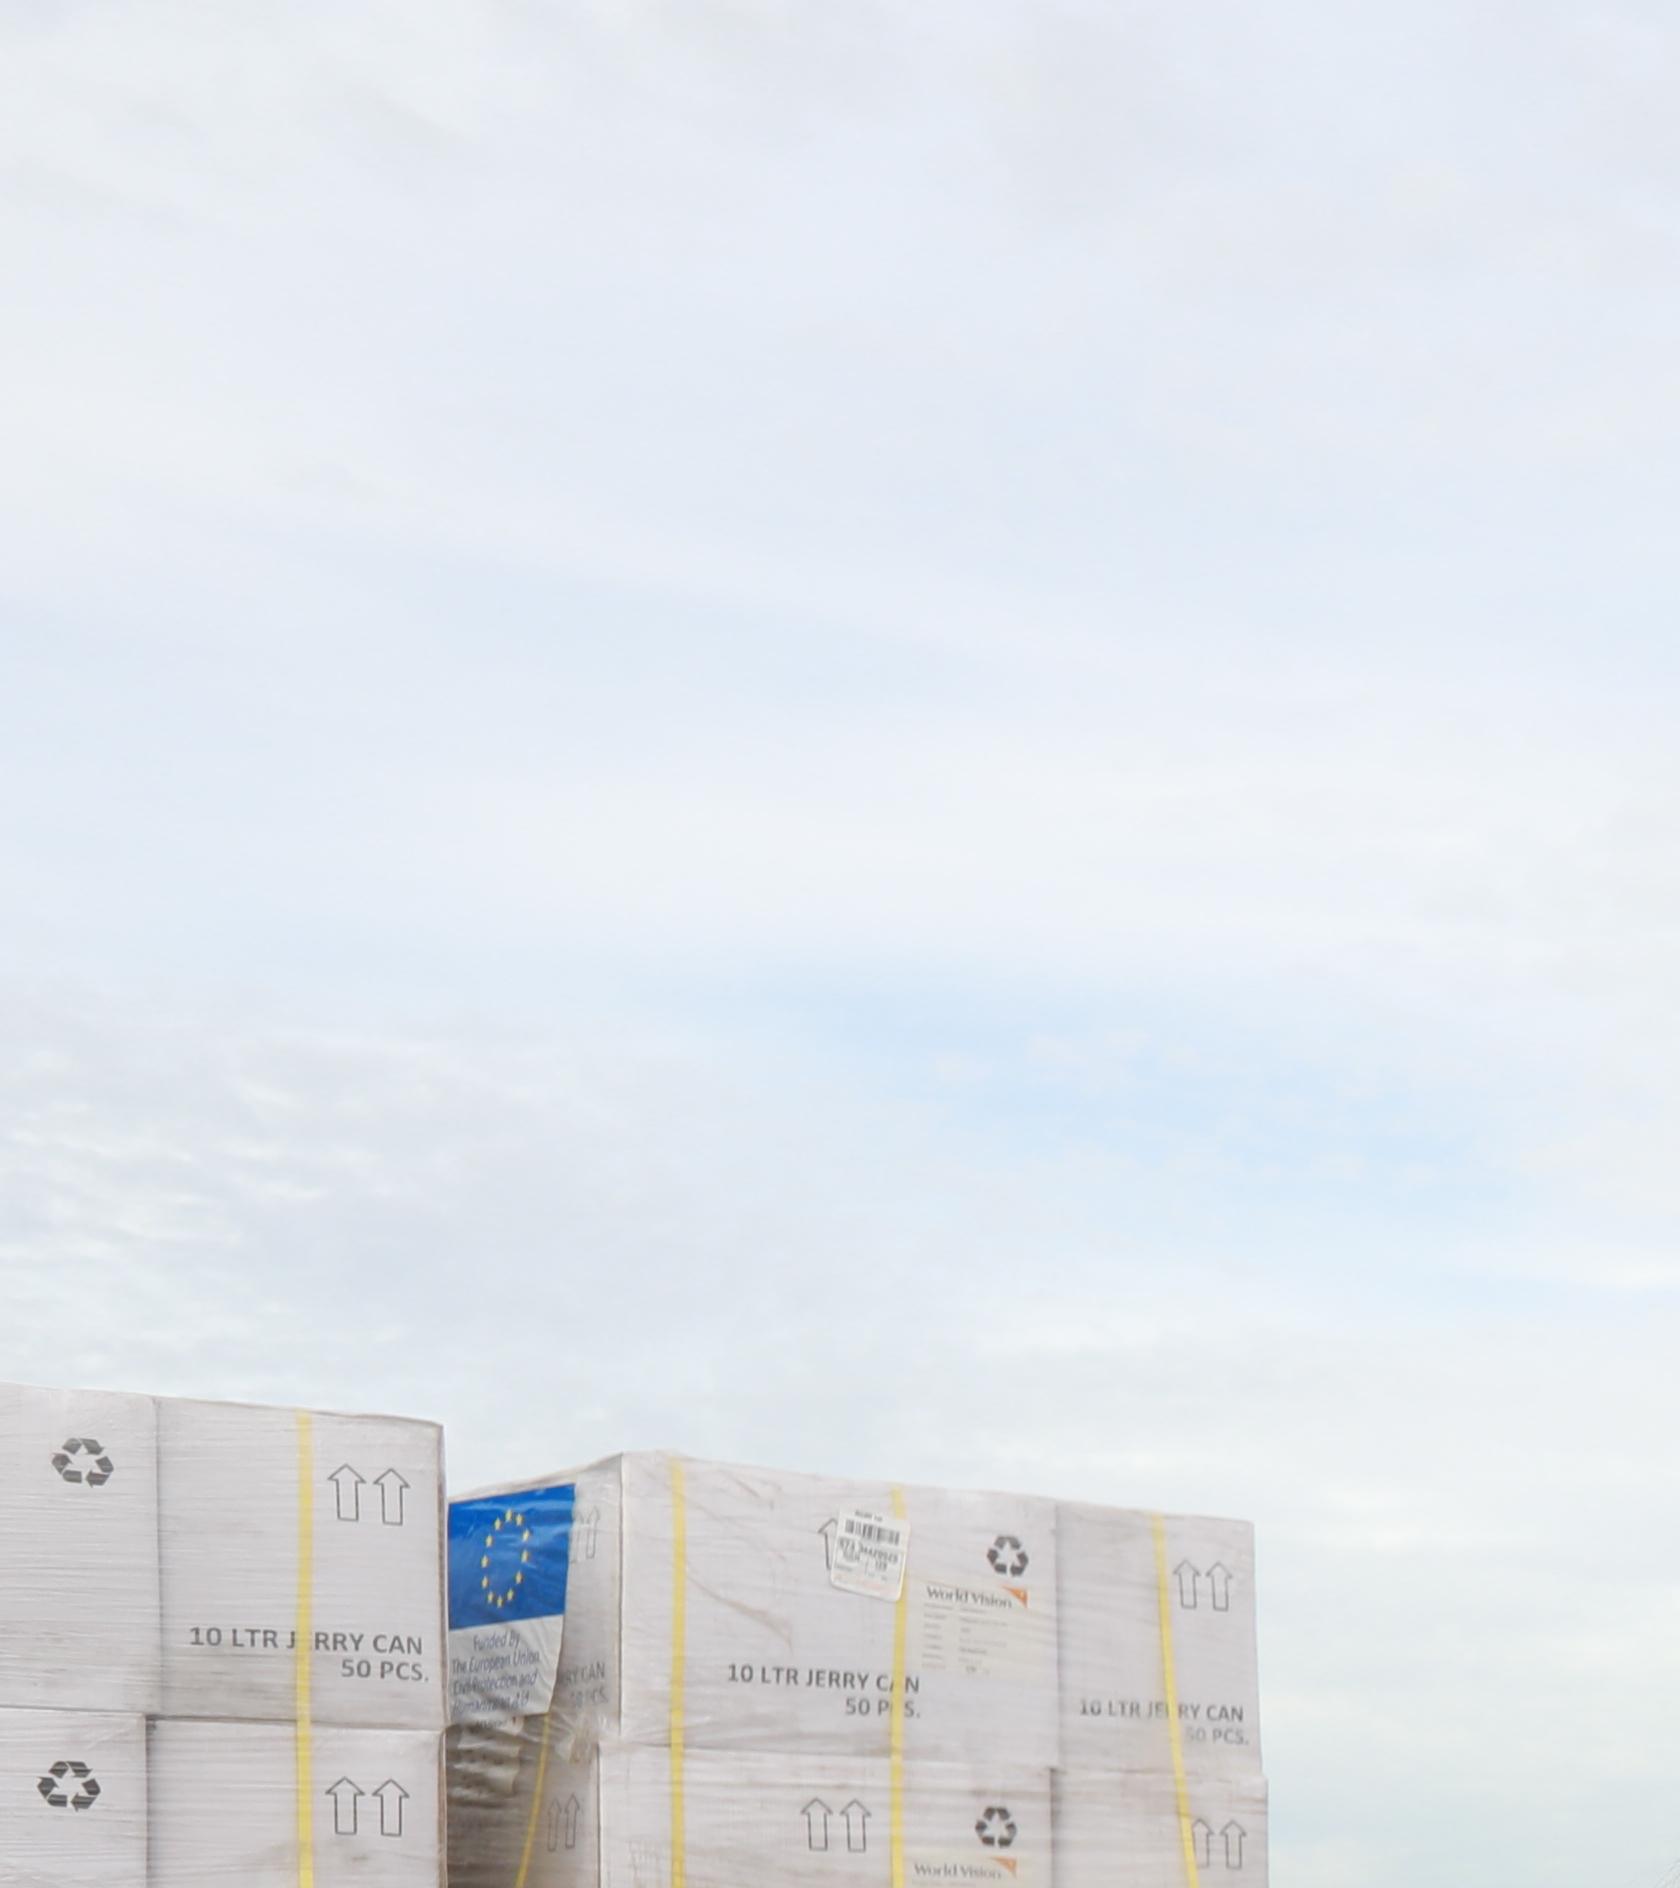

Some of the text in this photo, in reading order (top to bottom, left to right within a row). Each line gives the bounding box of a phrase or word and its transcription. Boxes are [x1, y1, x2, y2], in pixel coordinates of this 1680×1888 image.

[189, 1627, 423, 1655] 10 LTR JRRY CAN
[341, 1658, 430, 1683] 50 PCS.
[728, 1664, 756, 1684] 10
[760, 1666, 800, 1687] LTR
[805, 1668, 869, 1692] JERRY
[914, 1860, 1003, 1881] World Vision
